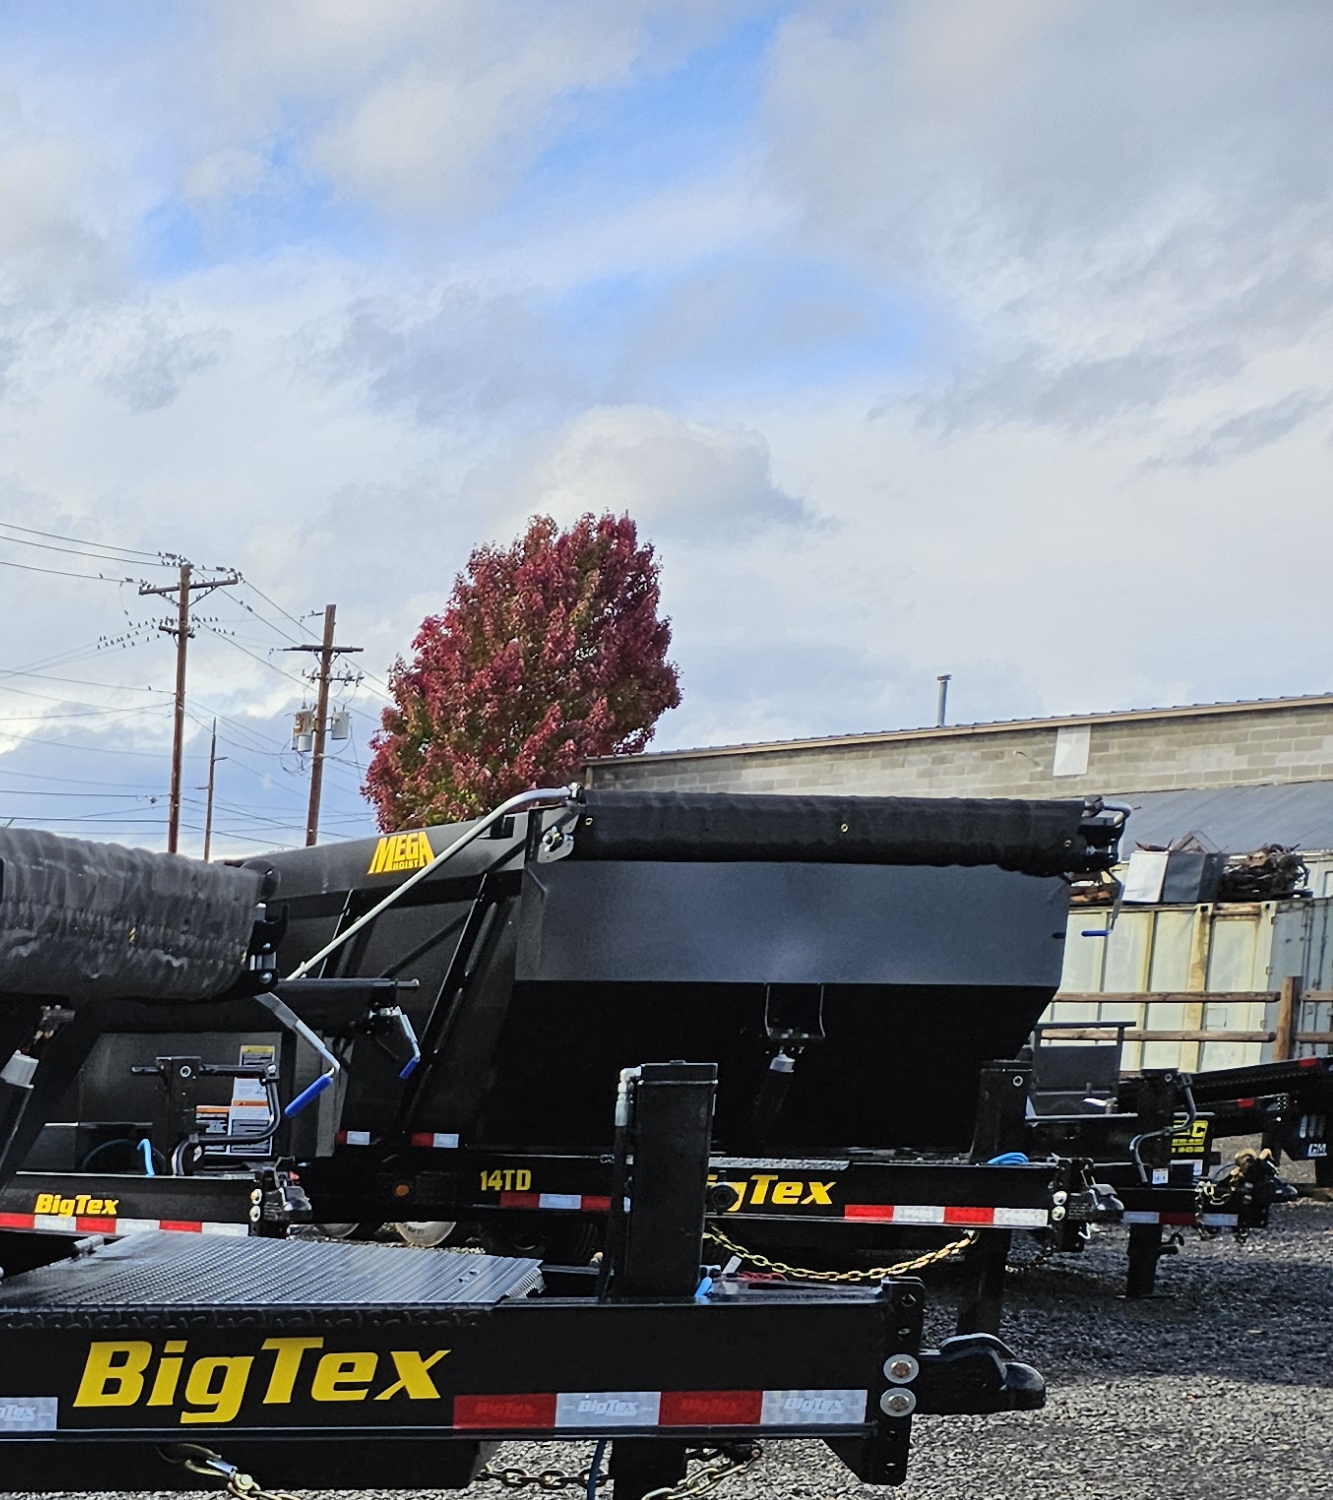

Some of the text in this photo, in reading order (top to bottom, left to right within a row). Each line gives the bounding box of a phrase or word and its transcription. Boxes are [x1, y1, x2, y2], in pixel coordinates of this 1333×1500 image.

[367, 831, 435, 875] MEGA
[480, 1169, 532, 1191] 14TD
[34, 1194, 119, 1217] BigTex
[73, 1337, 451, 1423] BigTex
